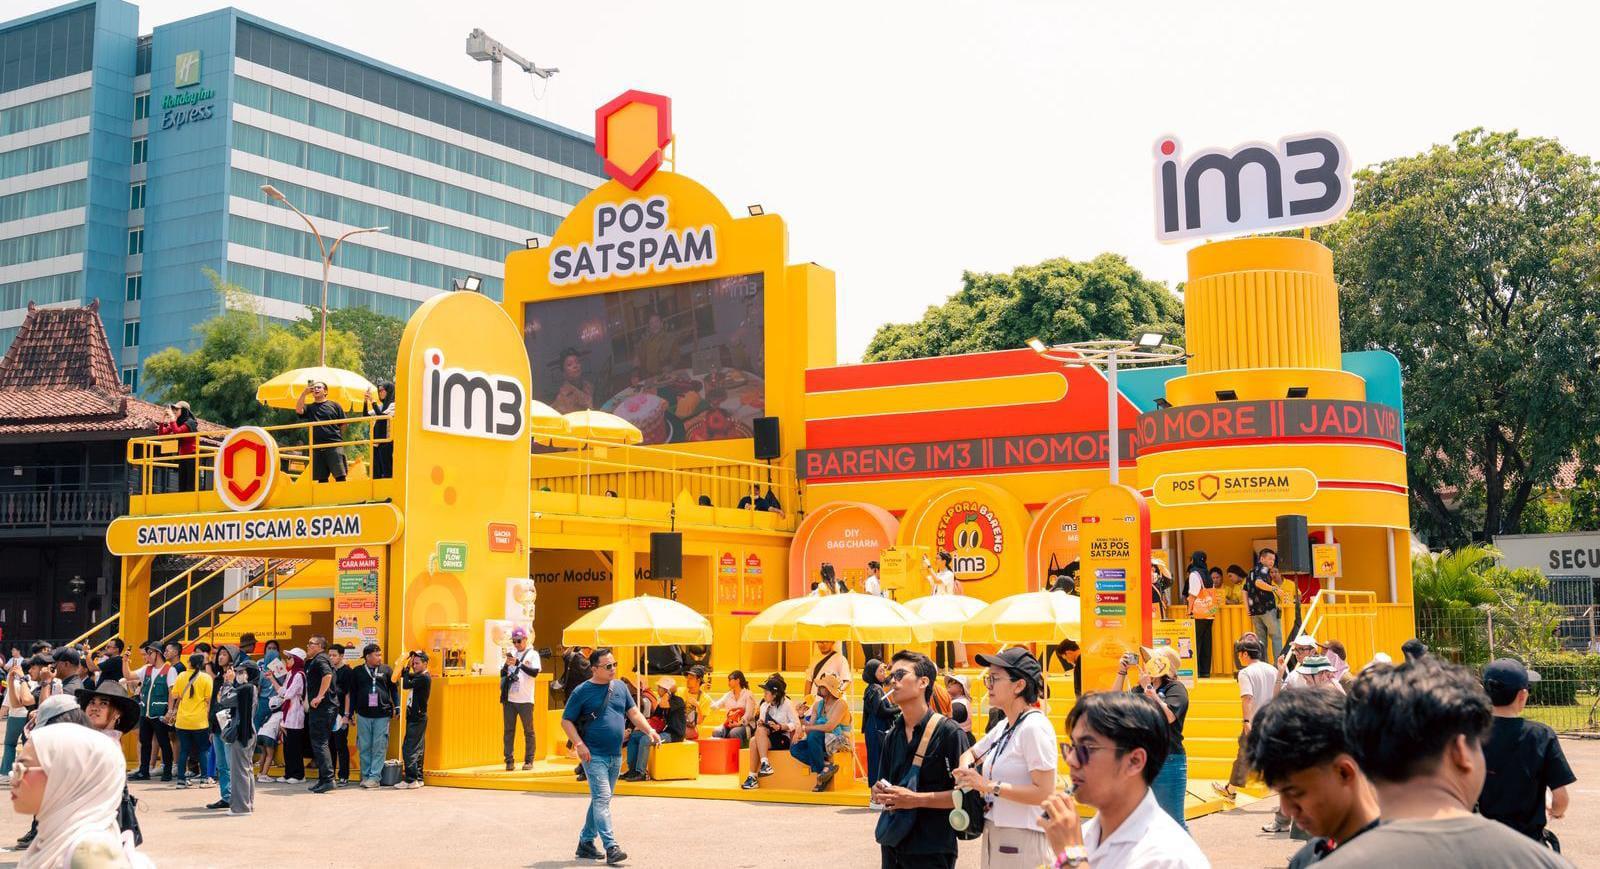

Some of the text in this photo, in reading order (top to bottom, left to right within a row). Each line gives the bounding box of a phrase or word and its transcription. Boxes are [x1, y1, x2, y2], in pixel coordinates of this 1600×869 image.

[163, 91, 198, 109] Holiday
[162, 105, 214, 130] Express
[1161, 137, 1342, 232] im3
[598, 200, 665, 236] POS
[553, 229, 713, 279] SATSPAM
[430, 354, 522, 437] im3
[1164, 406, 1255, 441] MORE
[1300, 405, 1368, 434] JADI
[807, 449, 916, 476] BARENG
[926, 443, 971, 469] IM3
[1172, 476, 1289, 492] POS SATSPAM
[138, 516, 359, 544] SATUAN ANTI SCAM & SPAM
[844, 529, 859, 538] DIY
[980, 505, 1003, 553] BARENG
[827, 540, 878, 549] BAG CHARM
[1091, 542, 1129, 550] IM3 POS
[564, 568, 606, 582] Modus
[954, 554, 985, 572] im3
